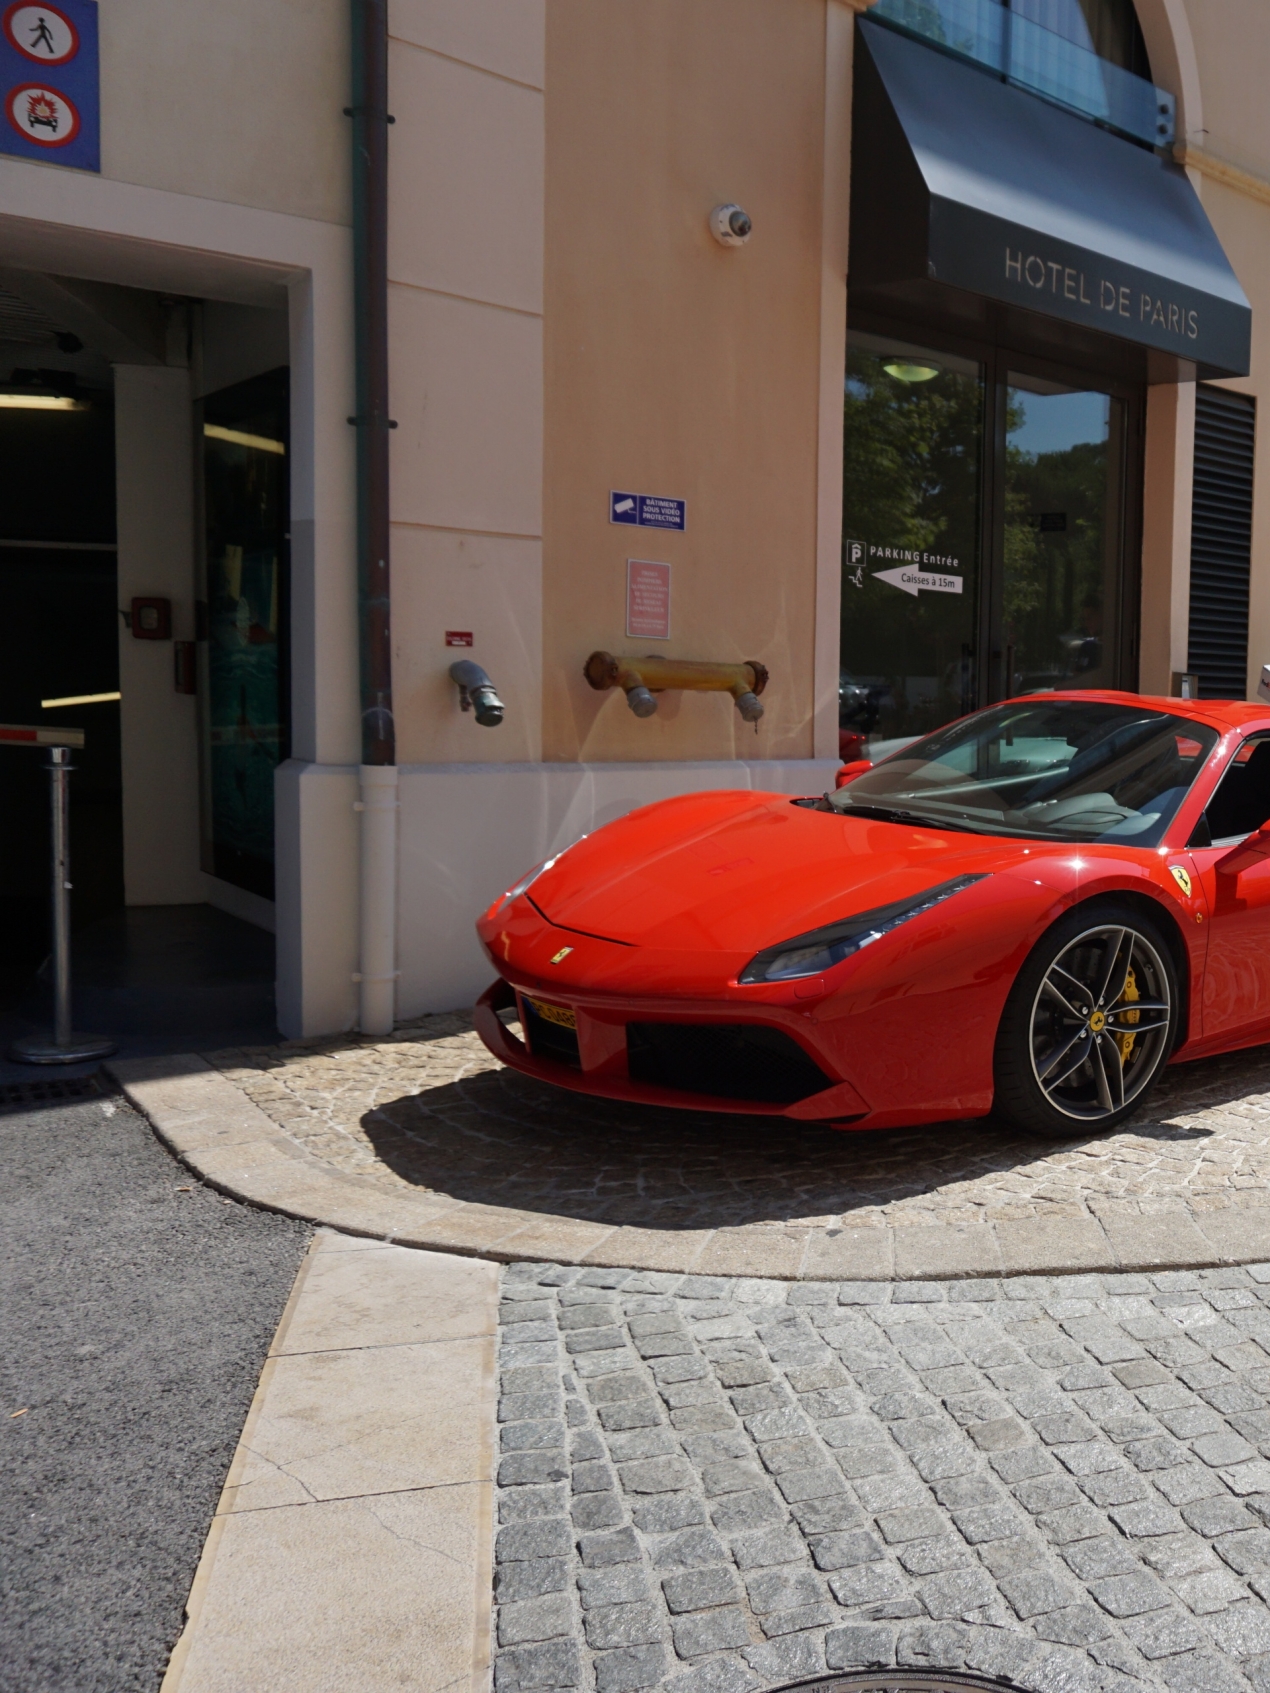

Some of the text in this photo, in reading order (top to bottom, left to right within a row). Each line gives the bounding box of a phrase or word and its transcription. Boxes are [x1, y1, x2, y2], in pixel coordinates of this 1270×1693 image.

[1005, 247, 1198, 340] HOTEL DE PARIS
[646, 498, 677, 508] BÂTIMENT
[643, 506, 680, 516] SOUS VIDÉO
[643, 512, 681, 523] PROTECTION
[870, 545, 959, 567] PARKING Entrée
[901, 573, 955, 588] Caisses à 15m
